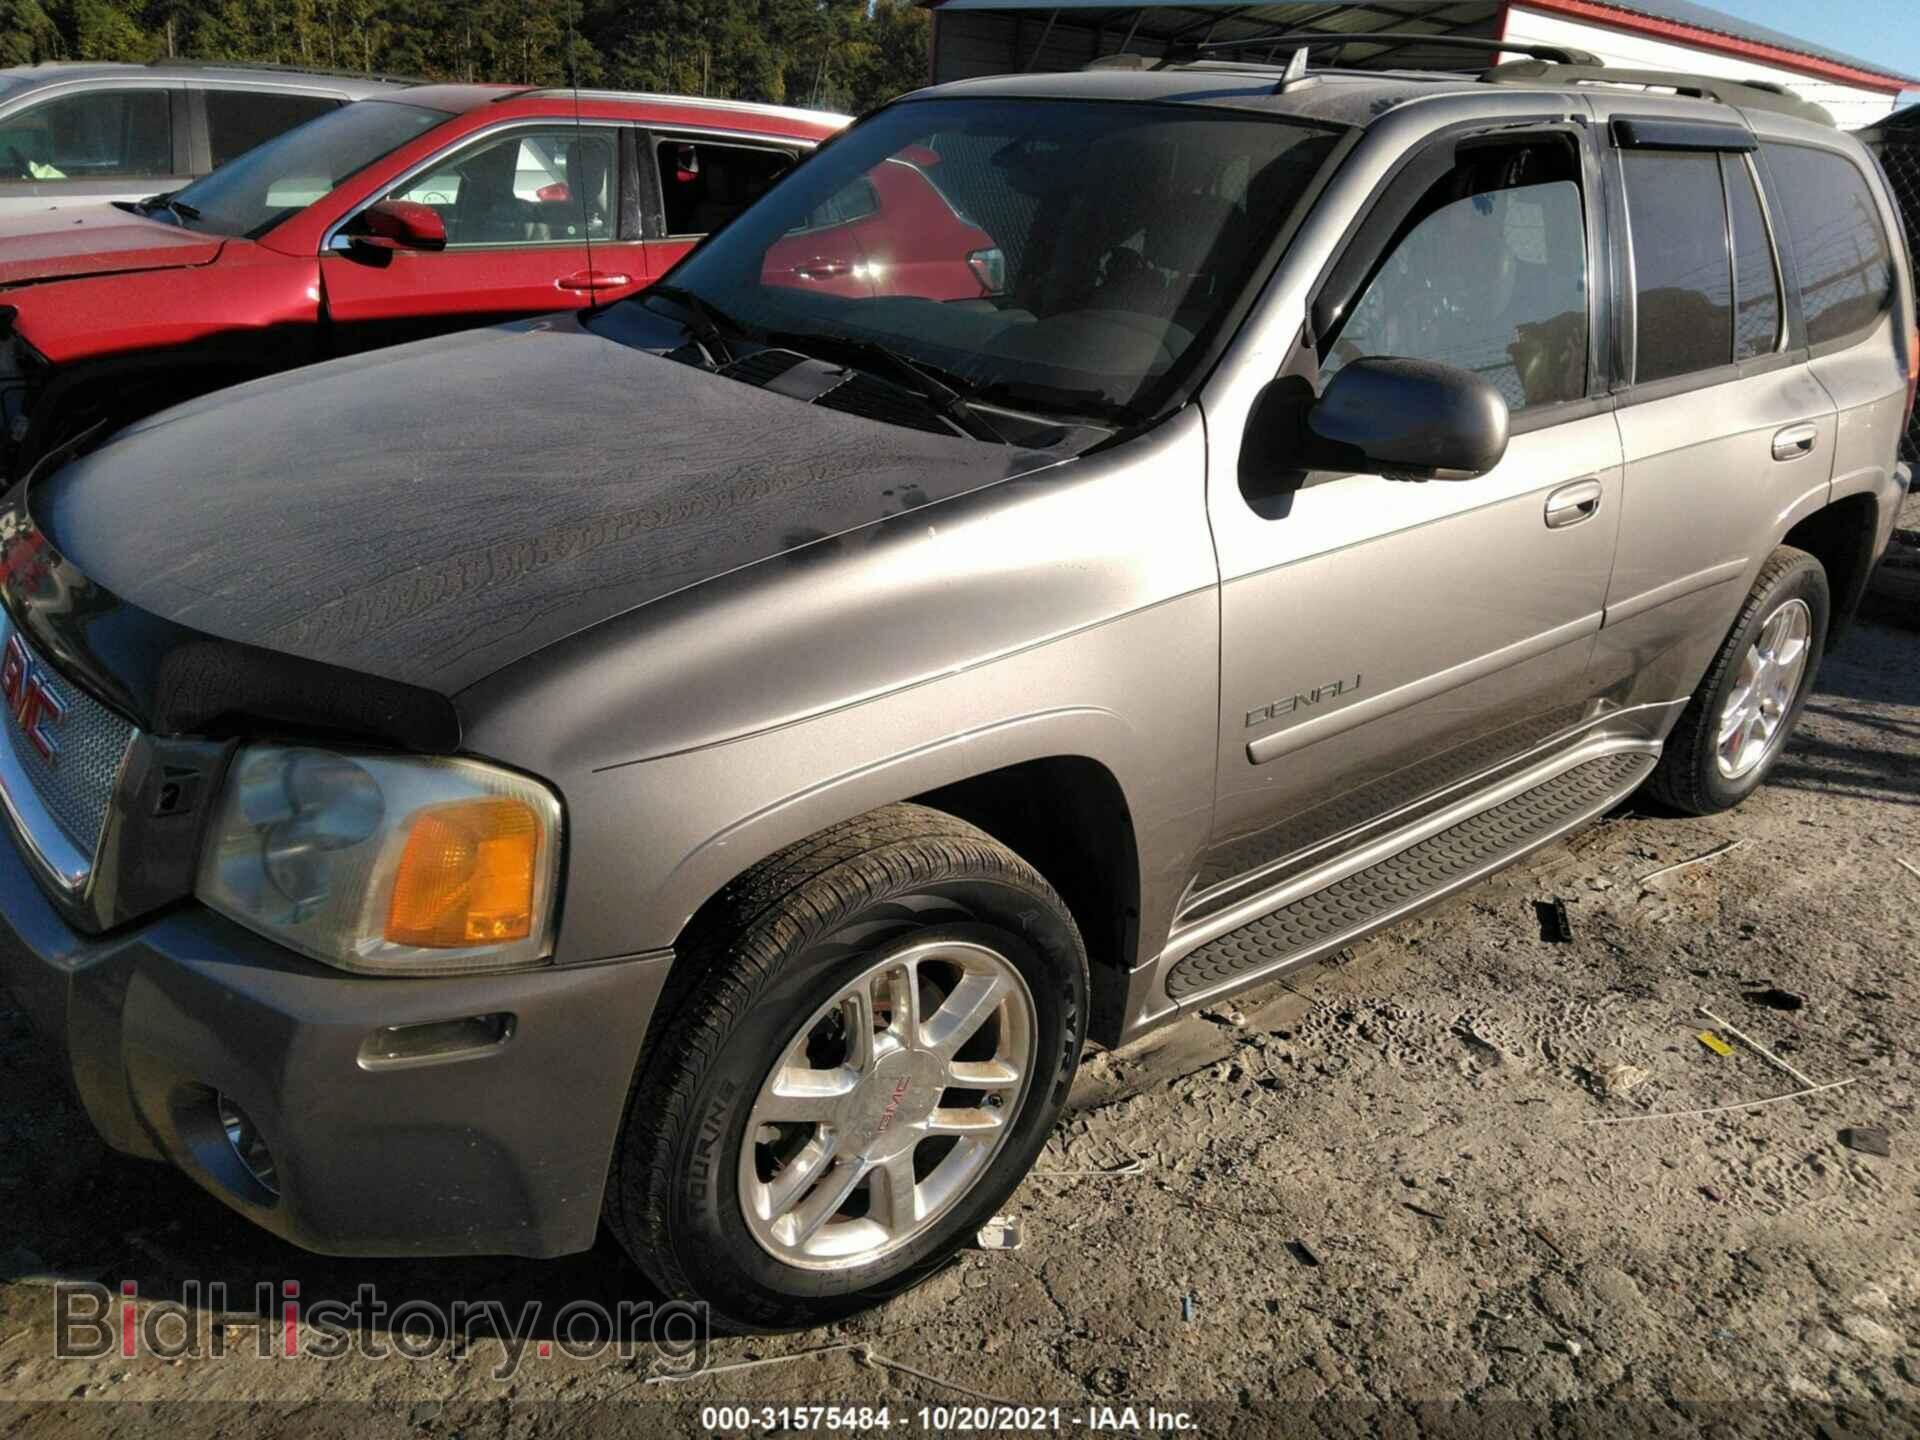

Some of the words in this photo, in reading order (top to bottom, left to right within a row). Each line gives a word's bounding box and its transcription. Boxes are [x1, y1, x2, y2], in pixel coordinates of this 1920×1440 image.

[3, 633, 66, 767] GMC
[1245, 672, 1361, 728] DENALI
[878, 1074, 912, 1132] GMC
